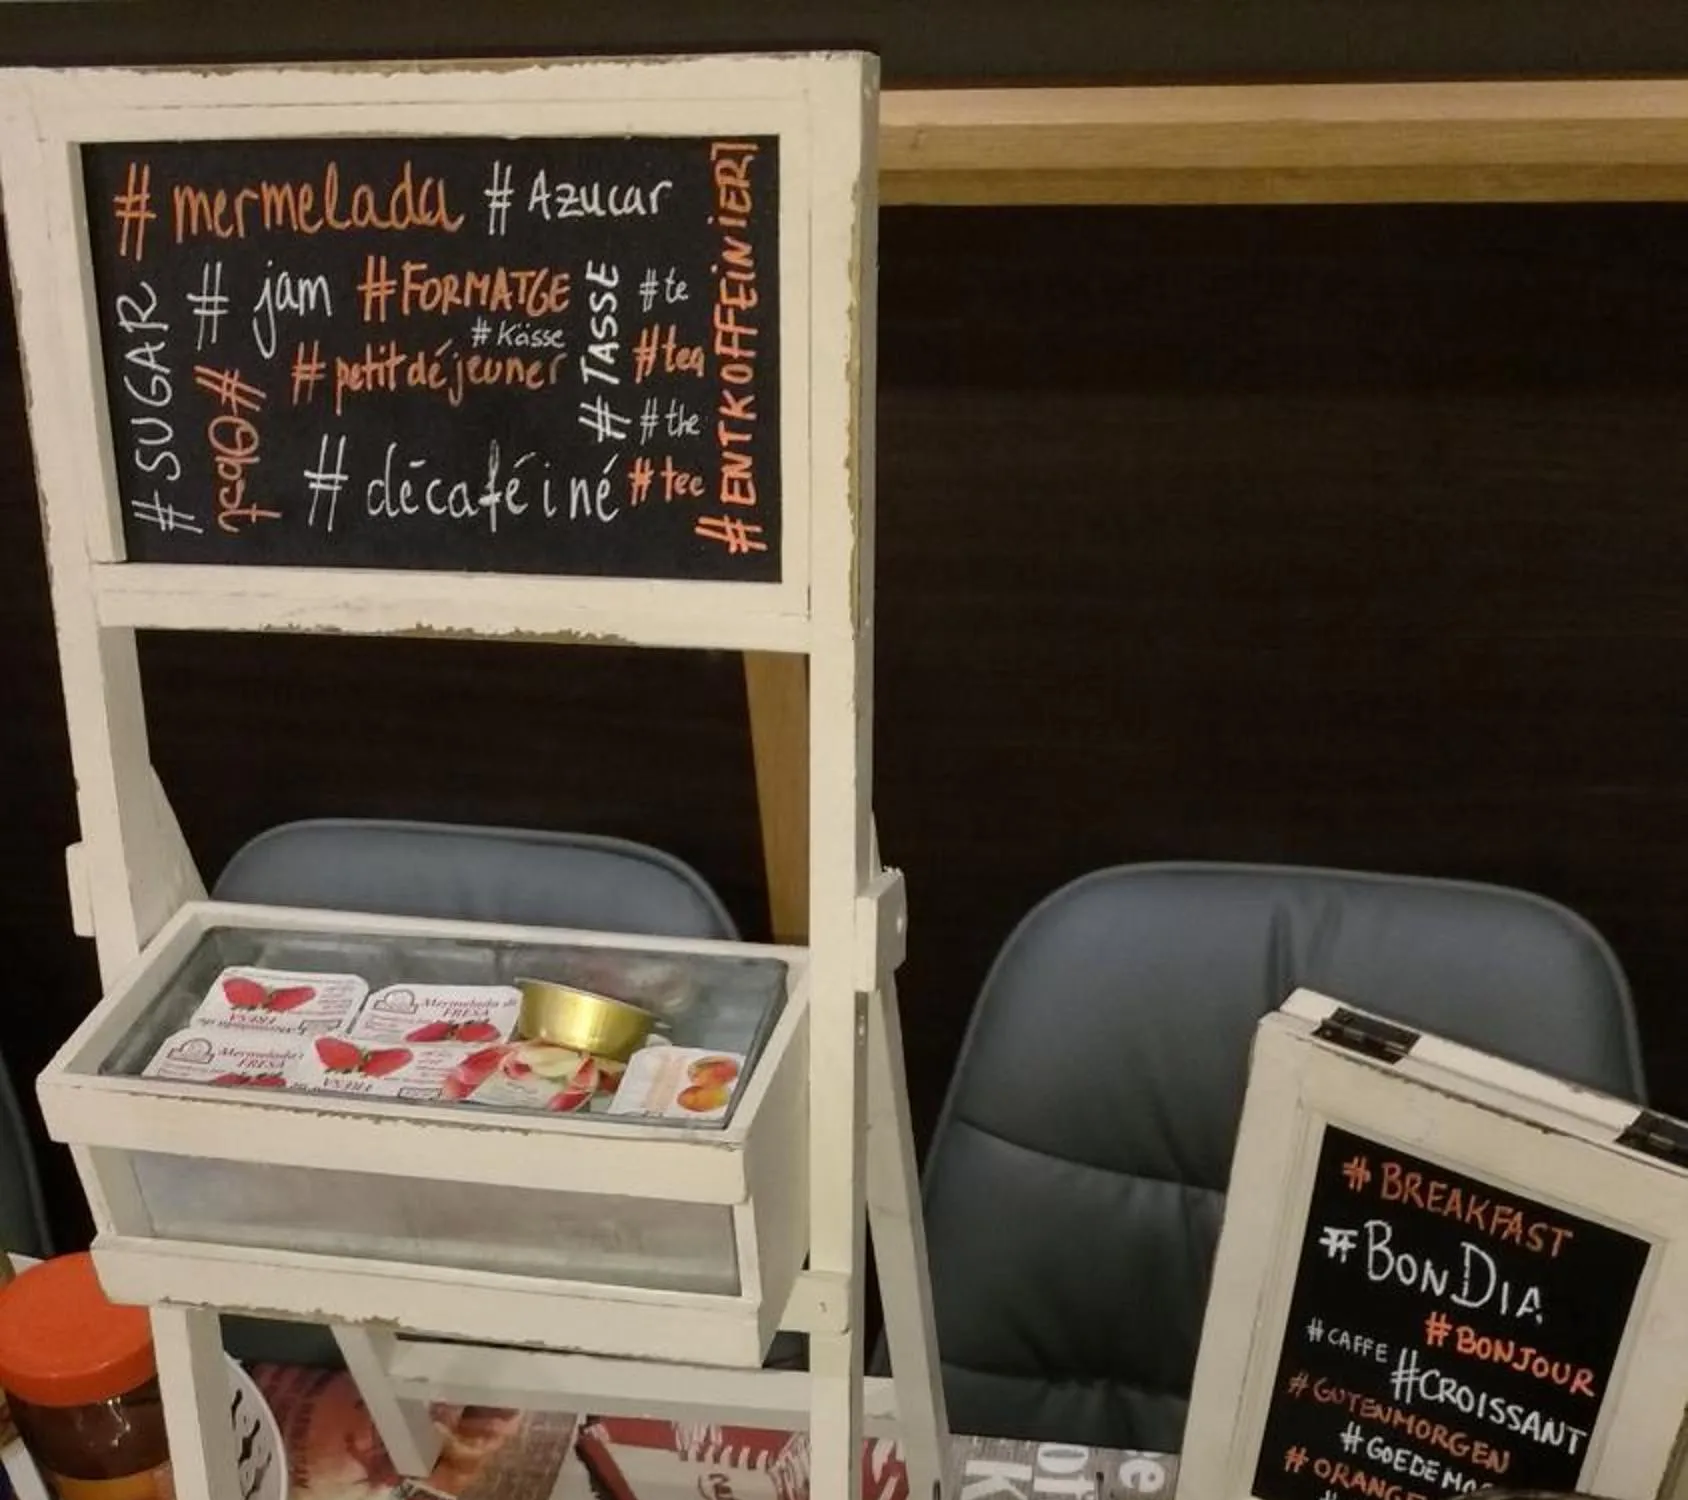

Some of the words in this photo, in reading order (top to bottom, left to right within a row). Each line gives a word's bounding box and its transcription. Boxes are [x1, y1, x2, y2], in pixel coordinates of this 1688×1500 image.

[357, 256, 570, 322] #FORMATGE
[578, 259, 632, 442] #TASSE
[115, 281, 204, 535] #SUGAR
[1342, 1155, 1574, 1260] #BREAKFAST
[1305, 1316, 1389, 1364] #CAFFE
[1424, 1310, 1596, 1397] #BONJOUR
[1391, 1347, 1588, 1457] #CROISSANT
